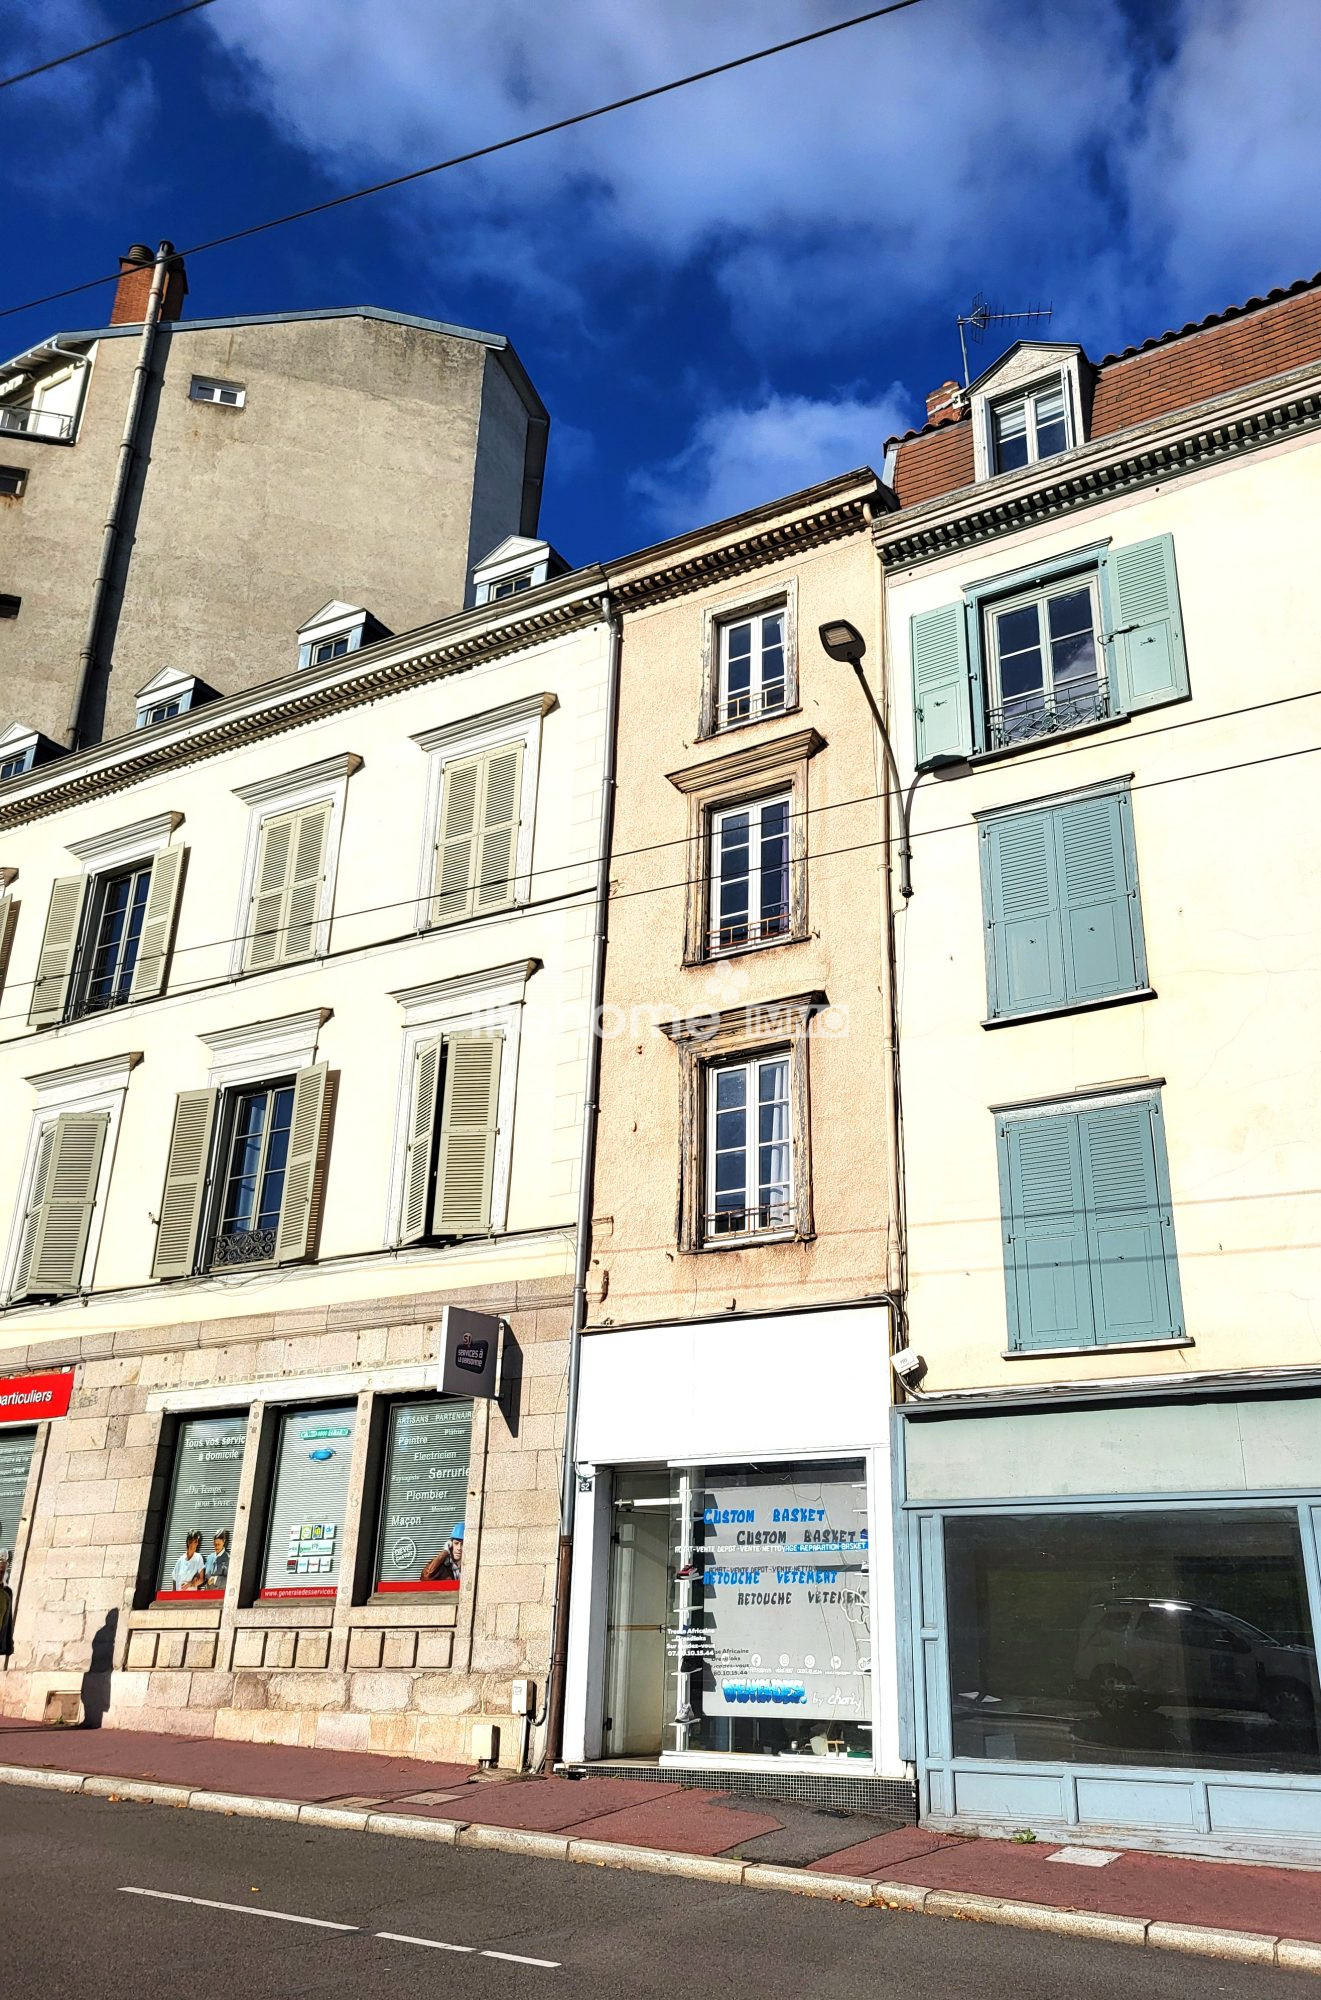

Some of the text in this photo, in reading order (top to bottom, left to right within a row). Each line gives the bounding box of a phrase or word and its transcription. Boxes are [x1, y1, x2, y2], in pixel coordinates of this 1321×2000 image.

[397, 1415, 429, 1424] ARTISANS
[185, 1437, 204, 1447] Tous
[205, 1436, 219, 1446] vos
[398, 1436, 428, 1446] Peintre
[205, 1448, 239, 1461] domicile
[414, 1450, 457, 1461] Electricien
[580, 1482, 590, 1491] 52
[406, 1489, 449, 1501] Plombier
[391, 1516, 422, 1528] Maçon
[703, 1507, 825, 1525] CUSTOM BASKET
[736, 1529, 857, 1546] CUSTOM BASKET
[703, 1571, 761, 1585] RETOUCHE
[738, 1592, 793, 1606] RETOUCHE
